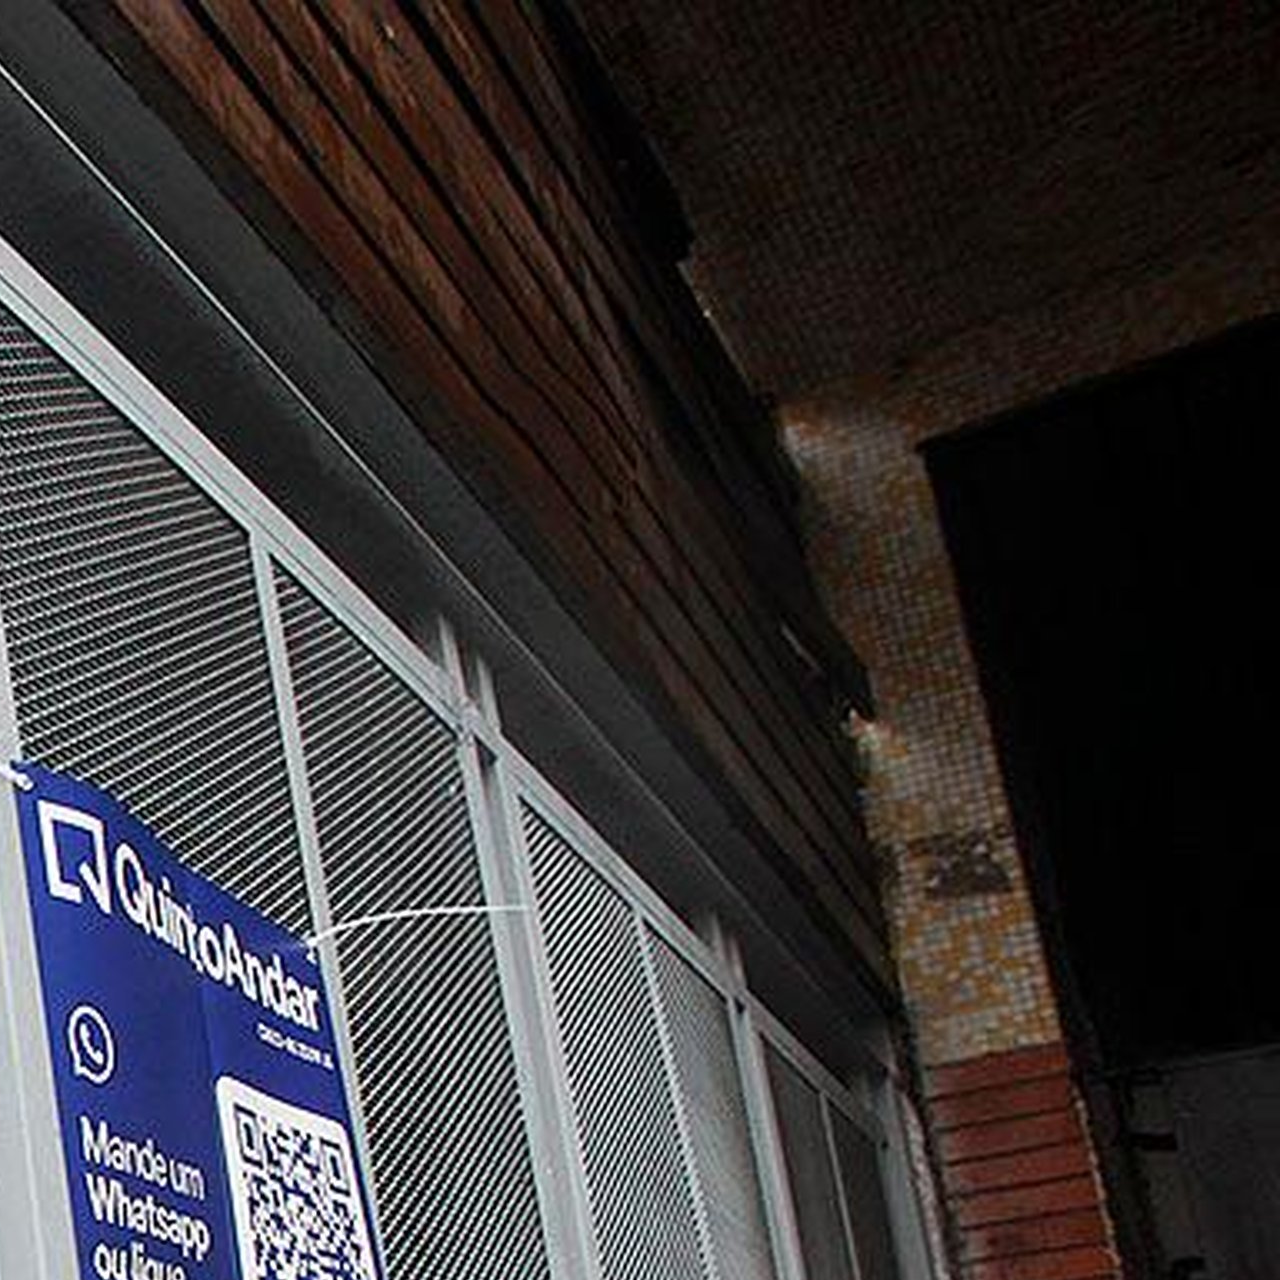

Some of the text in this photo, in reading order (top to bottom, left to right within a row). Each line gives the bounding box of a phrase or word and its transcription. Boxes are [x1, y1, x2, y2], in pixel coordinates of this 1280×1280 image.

[114, 841, 320, 1031] QuintoAndar
[79, 1115, 206, 1201] Mande um
[85, 1172, 212, 1263] Whatsapp
